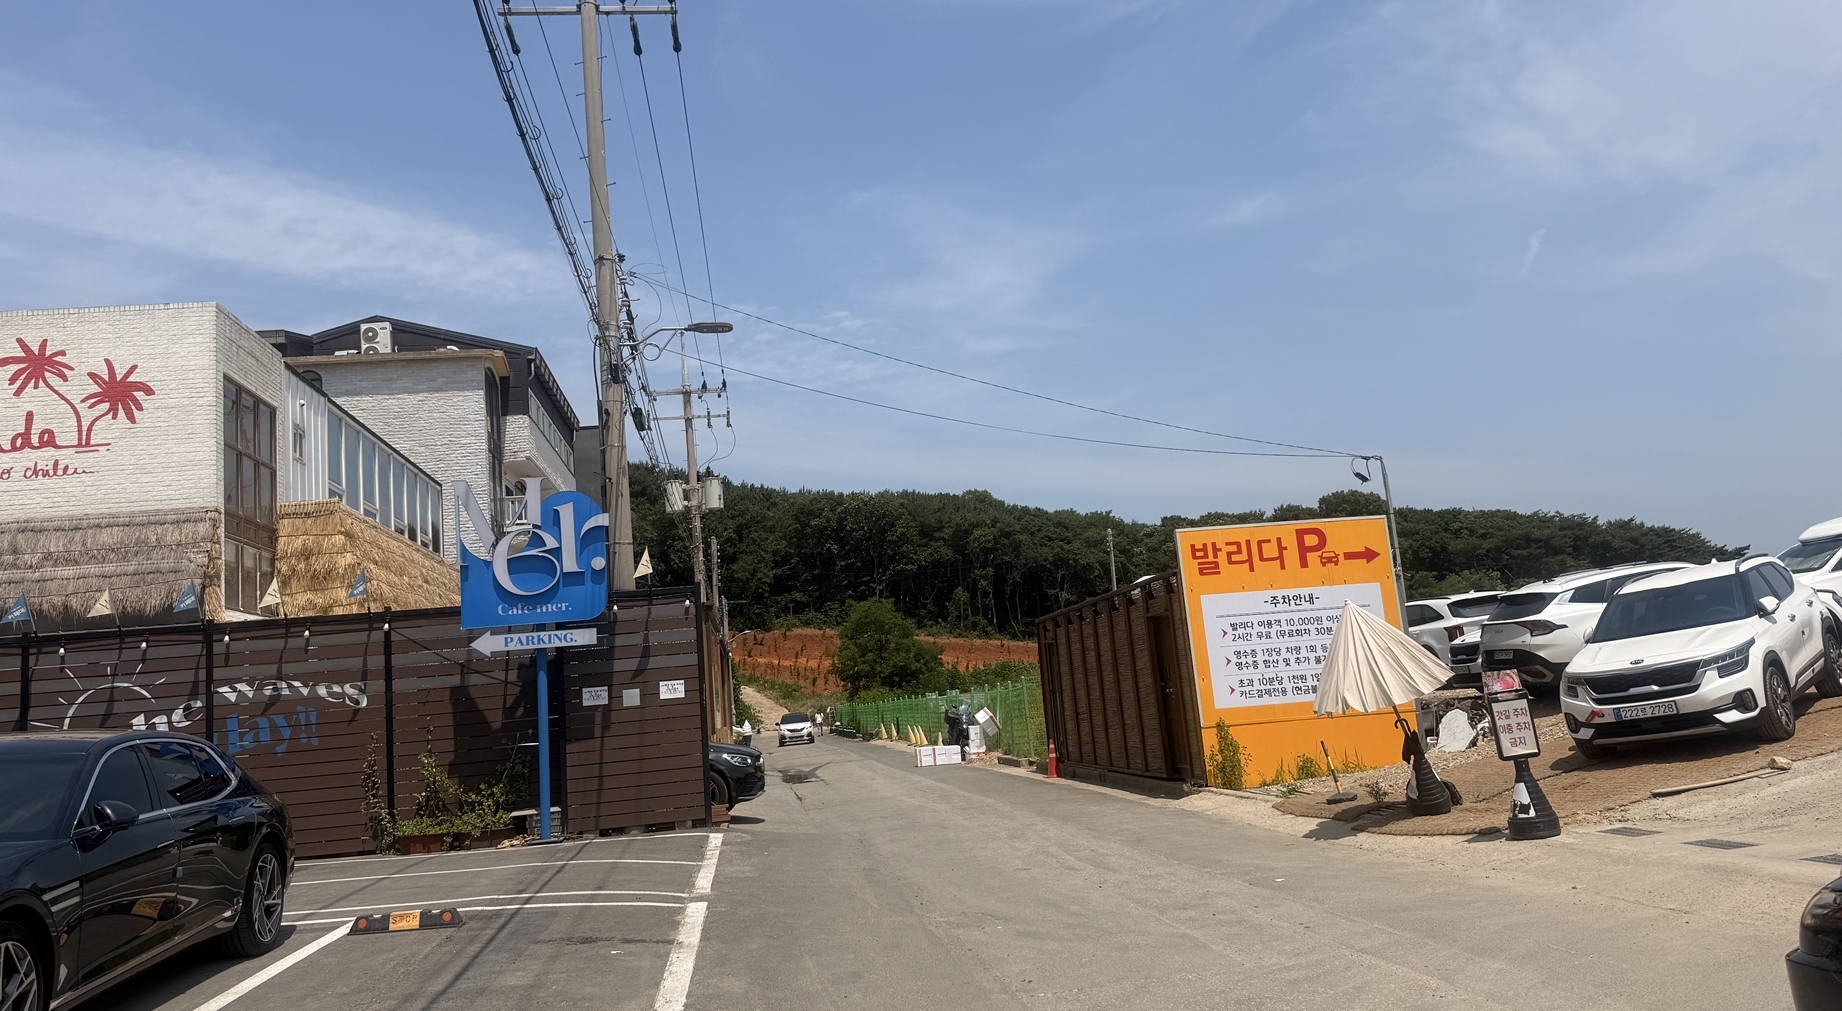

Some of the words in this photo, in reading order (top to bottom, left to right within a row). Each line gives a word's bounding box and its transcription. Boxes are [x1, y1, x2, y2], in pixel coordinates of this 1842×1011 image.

[0, 410, 58, 453] da
[1190, 536, 1288, 576] 발리다
[1295, 527, 1327, 568] P
[497, 603, 532, 616] Cafe
[536, 602, 572, 613] mer.
[1230, 621, 1254, 631] 발리다
[1257, 619, 1282, 629] 이용객
[503, 632, 578, 648] PARKING.
[1231, 632, 1253, 642] 2시간
[1256, 630, 1272, 640] 무료
[1275, 628, 1311, 640] (무료회차
[1315, 626, 1334, 636] 30분
[1233, 649, 1258, 660] 영수증
[1261, 647, 1282, 657] 1장당
[1285, 645, 1301, 657] 차량
[1305, 643, 1317, 654] 1회
[1321, 643, 1331, 653] 등
[1235, 660, 1259, 671] 영수증
[1263, 658, 1279, 668] 합산
[1283, 657, 1292, 667] 및
[1295, 656, 1310, 666] 추가
[1238, 678, 1255, 688] 초과
[1257, 676, 1284, 686] 10분당
[1287, 673, 1307, 685] 1천원
[216, 679, 369, 708] waves
[1239, 687, 1288, 699] 카드결제전용
[1495, 709, 1511, 721] 갓길
[1512, 707, 1528, 719] 주차
[1649, 703, 1674, 715] 2728
[1499, 723, 1514, 734] 이중
[1516, 721, 1531, 732] 주차
[1509, 736, 1527, 748] 금지
[391, 914, 418, 925] STOP
